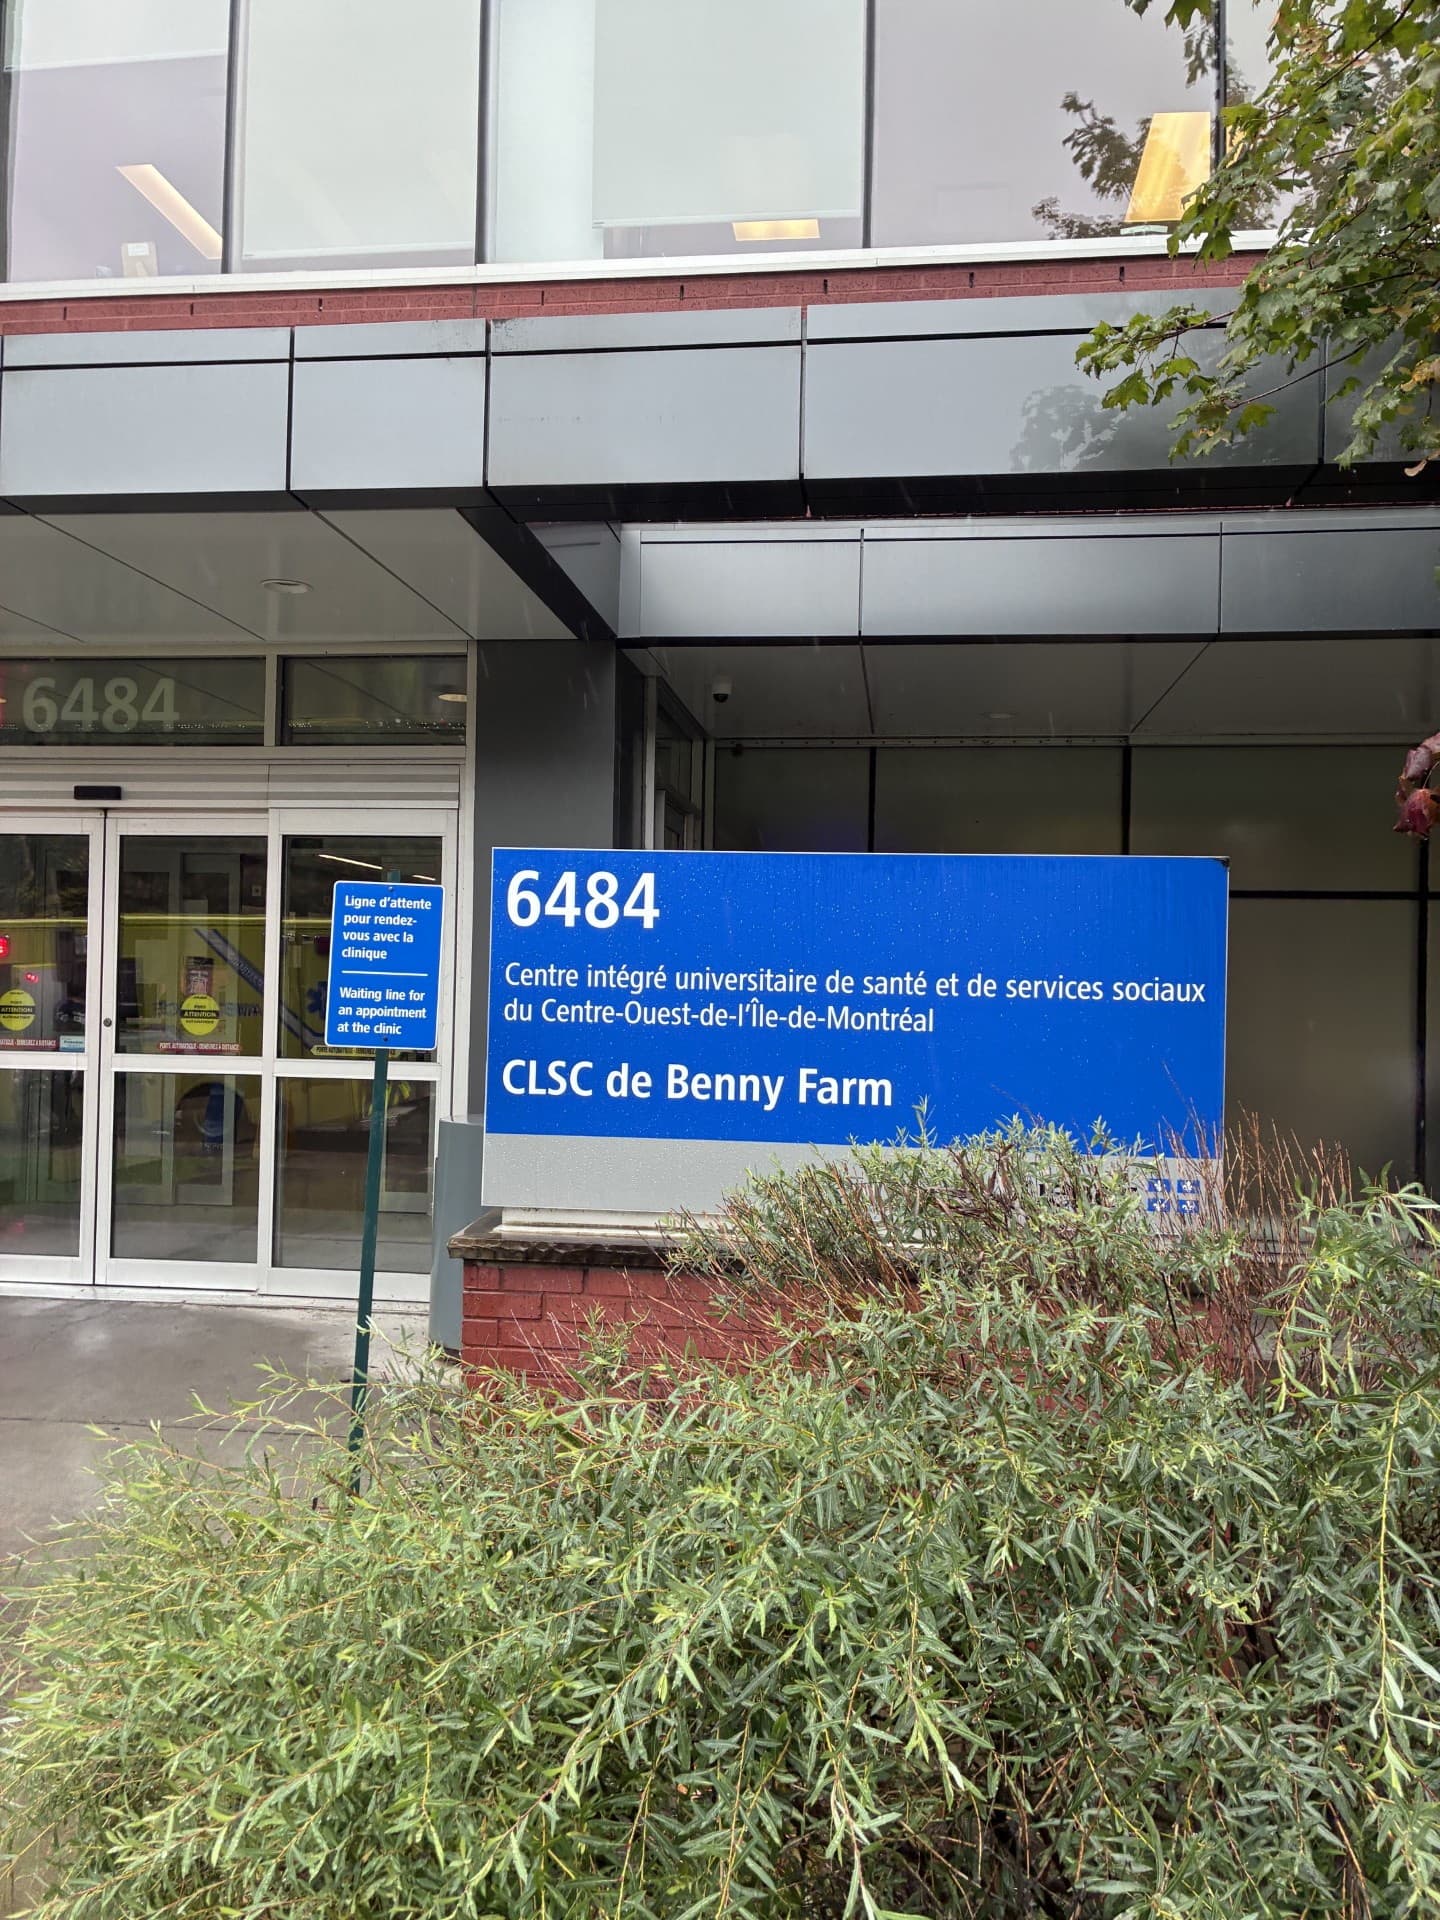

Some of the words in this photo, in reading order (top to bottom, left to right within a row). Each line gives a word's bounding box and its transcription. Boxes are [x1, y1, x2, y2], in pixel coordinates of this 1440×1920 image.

[22, 677, 181, 734] 6484
[344, 895, 377, 910] Ligne
[379, 897, 433, 910] d'attente
[506, 869, 660, 929] 6484
[343, 915, 371, 927] pour
[374, 915, 418, 927] rendez-
[342, 931, 370, 941] vous
[373, 932, 400, 943] avec
[402, 931, 414, 943] la
[341, 946, 388, 961] clinique
[505, 961, 579, 988] Centre
[586, 961, 668, 995] intégré
[674, 967, 818, 994] universitaire
[824, 969, 856, 994] de
[862, 970, 928, 996] santé
[935, 975, 960, 997] et
[967, 973, 998, 998] de
[1005, 975, 1104, 1001] services
[1112, 977, 1206, 1003] sociaux
[339, 986, 382, 1002] Waiting
[385, 988, 406, 1001] line
[408, 989, 426, 1001] for
[337, 1006, 353, 1016] an
[355, 1006, 428, 1019] appointment
[503, 997, 533, 1022] du
[336, 1022, 349, 1033] at
[352, 1022, 371, 1034] the
[373, 1023, 403, 1035] clinic
[502, 1059, 593, 1098] CLSC
[606, 1062, 653, 1099] de
[667, 1063, 785, 1111] Benny
[798, 1067, 892, 1107] Farm
